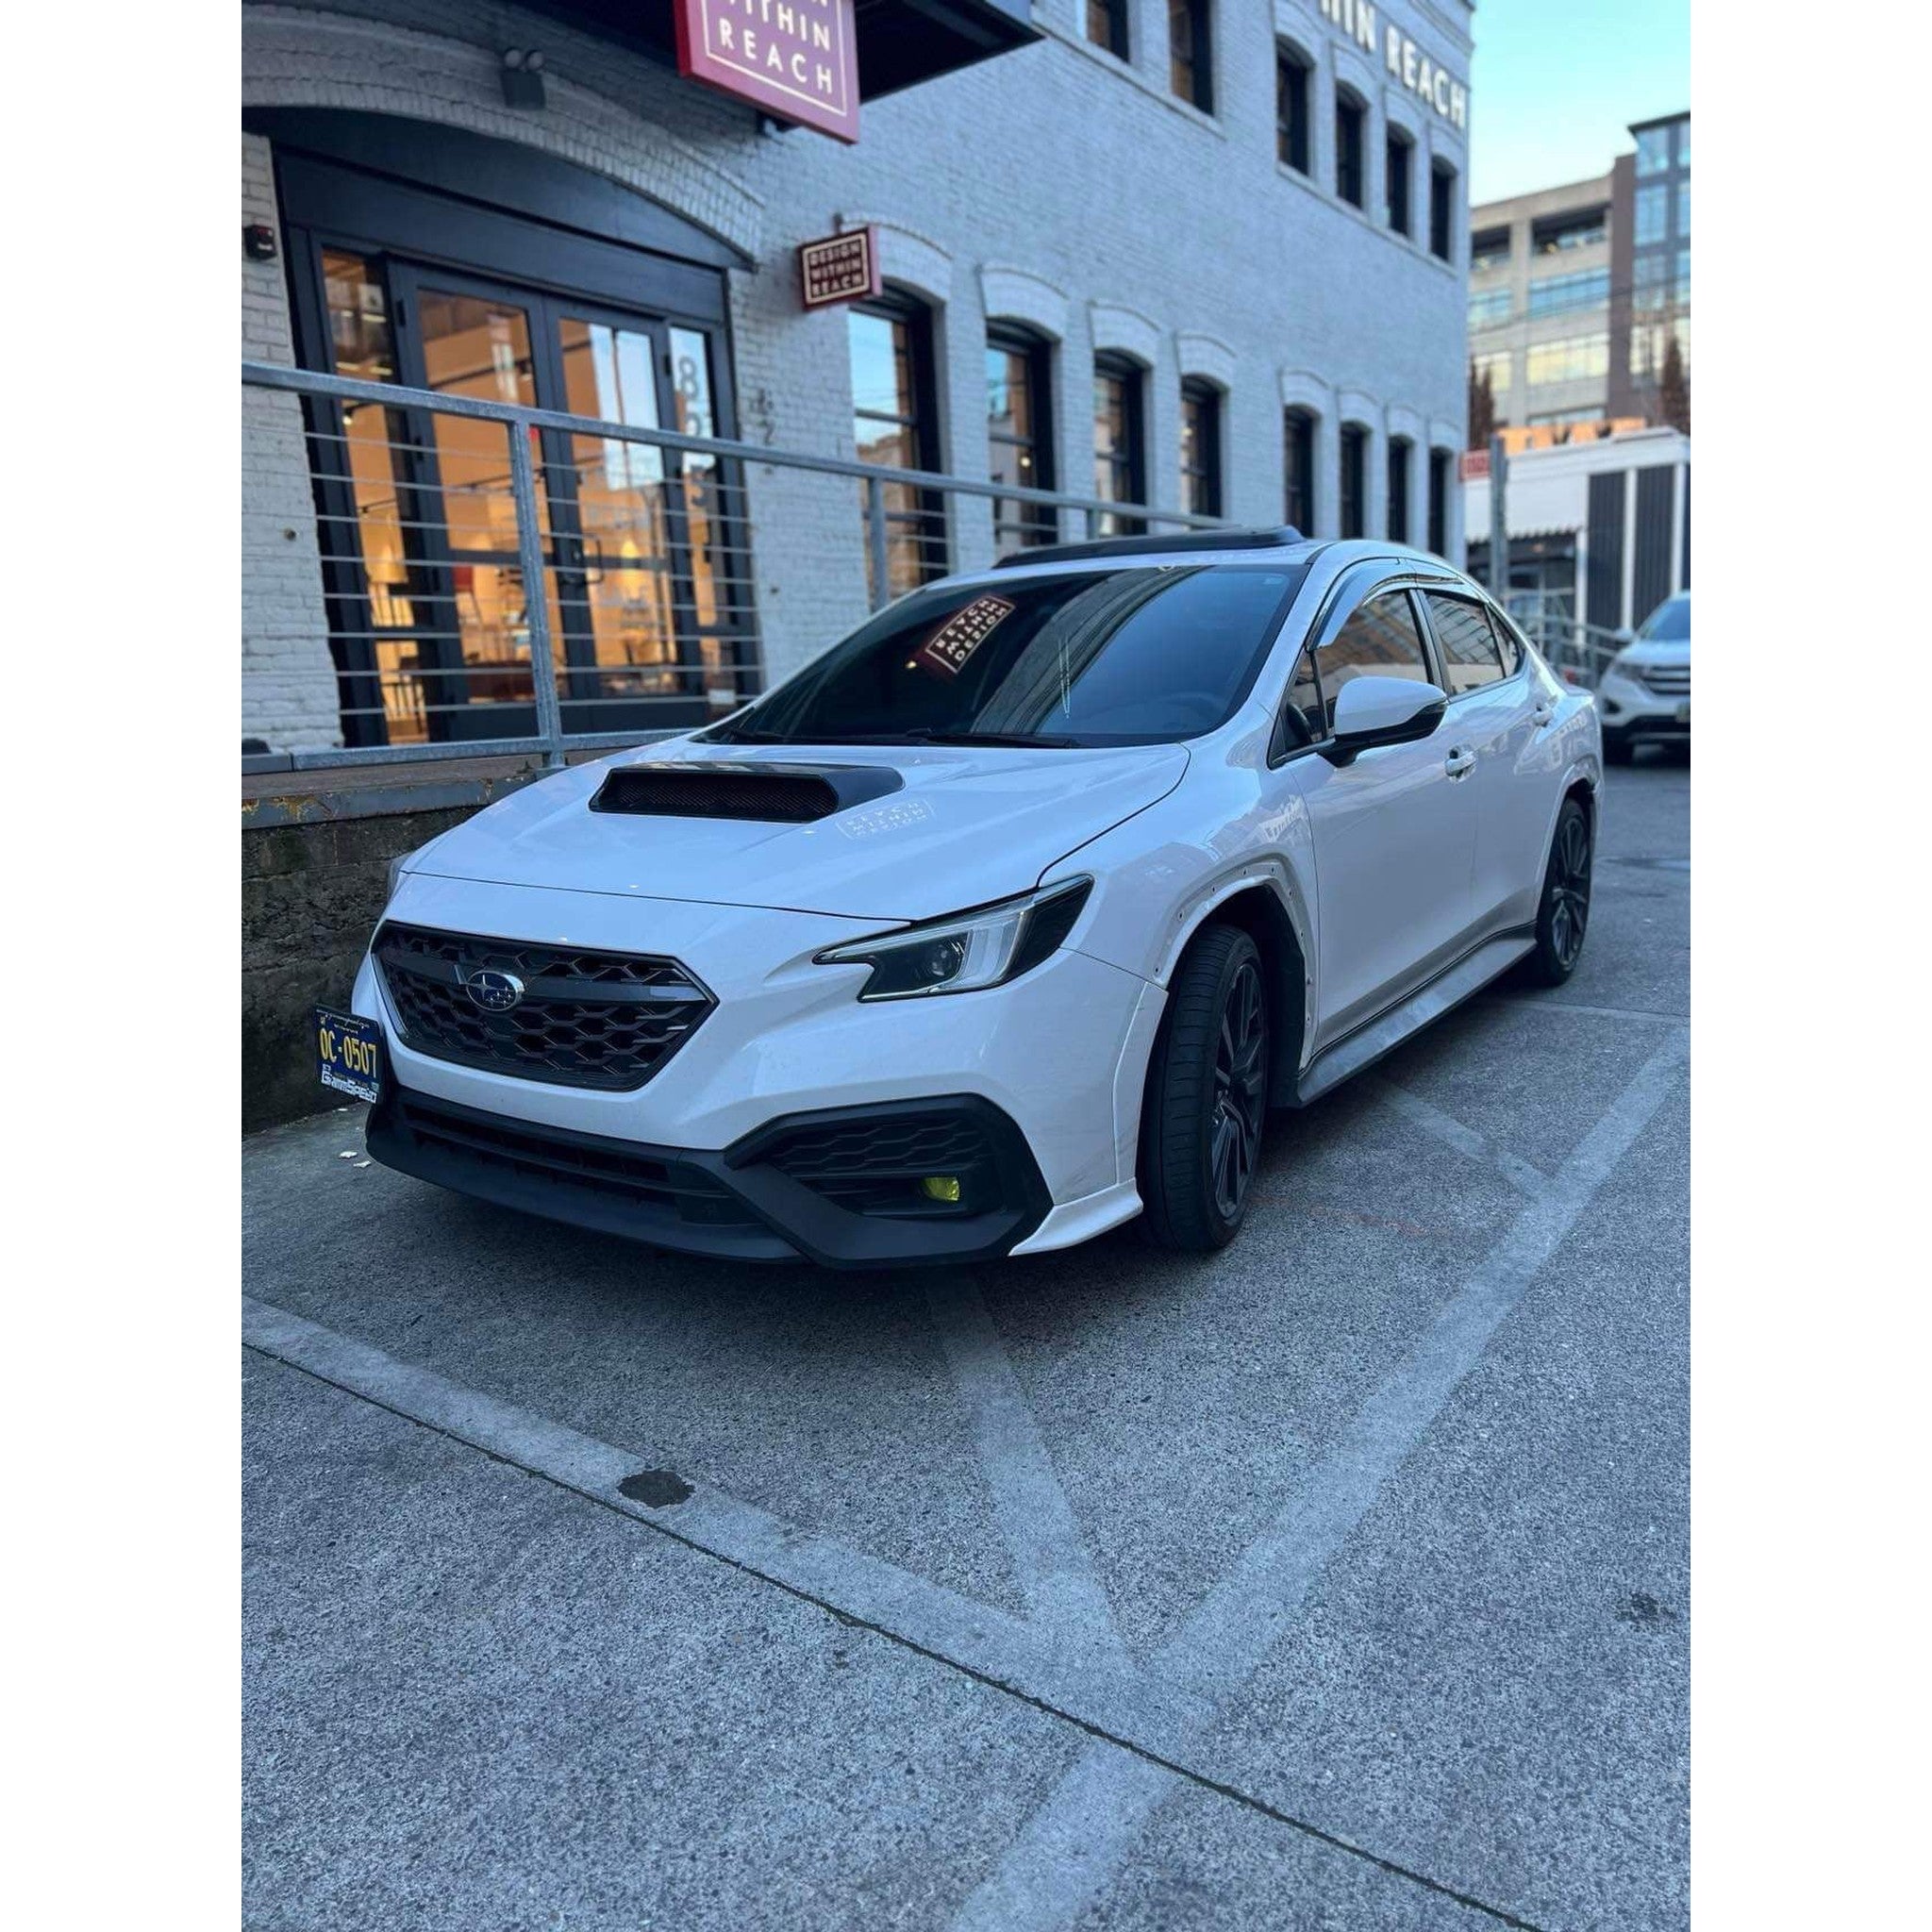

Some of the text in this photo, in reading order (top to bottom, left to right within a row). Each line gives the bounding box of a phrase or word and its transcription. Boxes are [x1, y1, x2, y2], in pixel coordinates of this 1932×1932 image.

[729, 0, 831, 52] ITHIN
[719, 17, 833, 95] REACH
[1387, 24, 1466, 129] REACH
[809, 242, 861, 266] DESIGN
[810, 258, 862, 281] WITHIN
[811, 273, 863, 296] REACH
